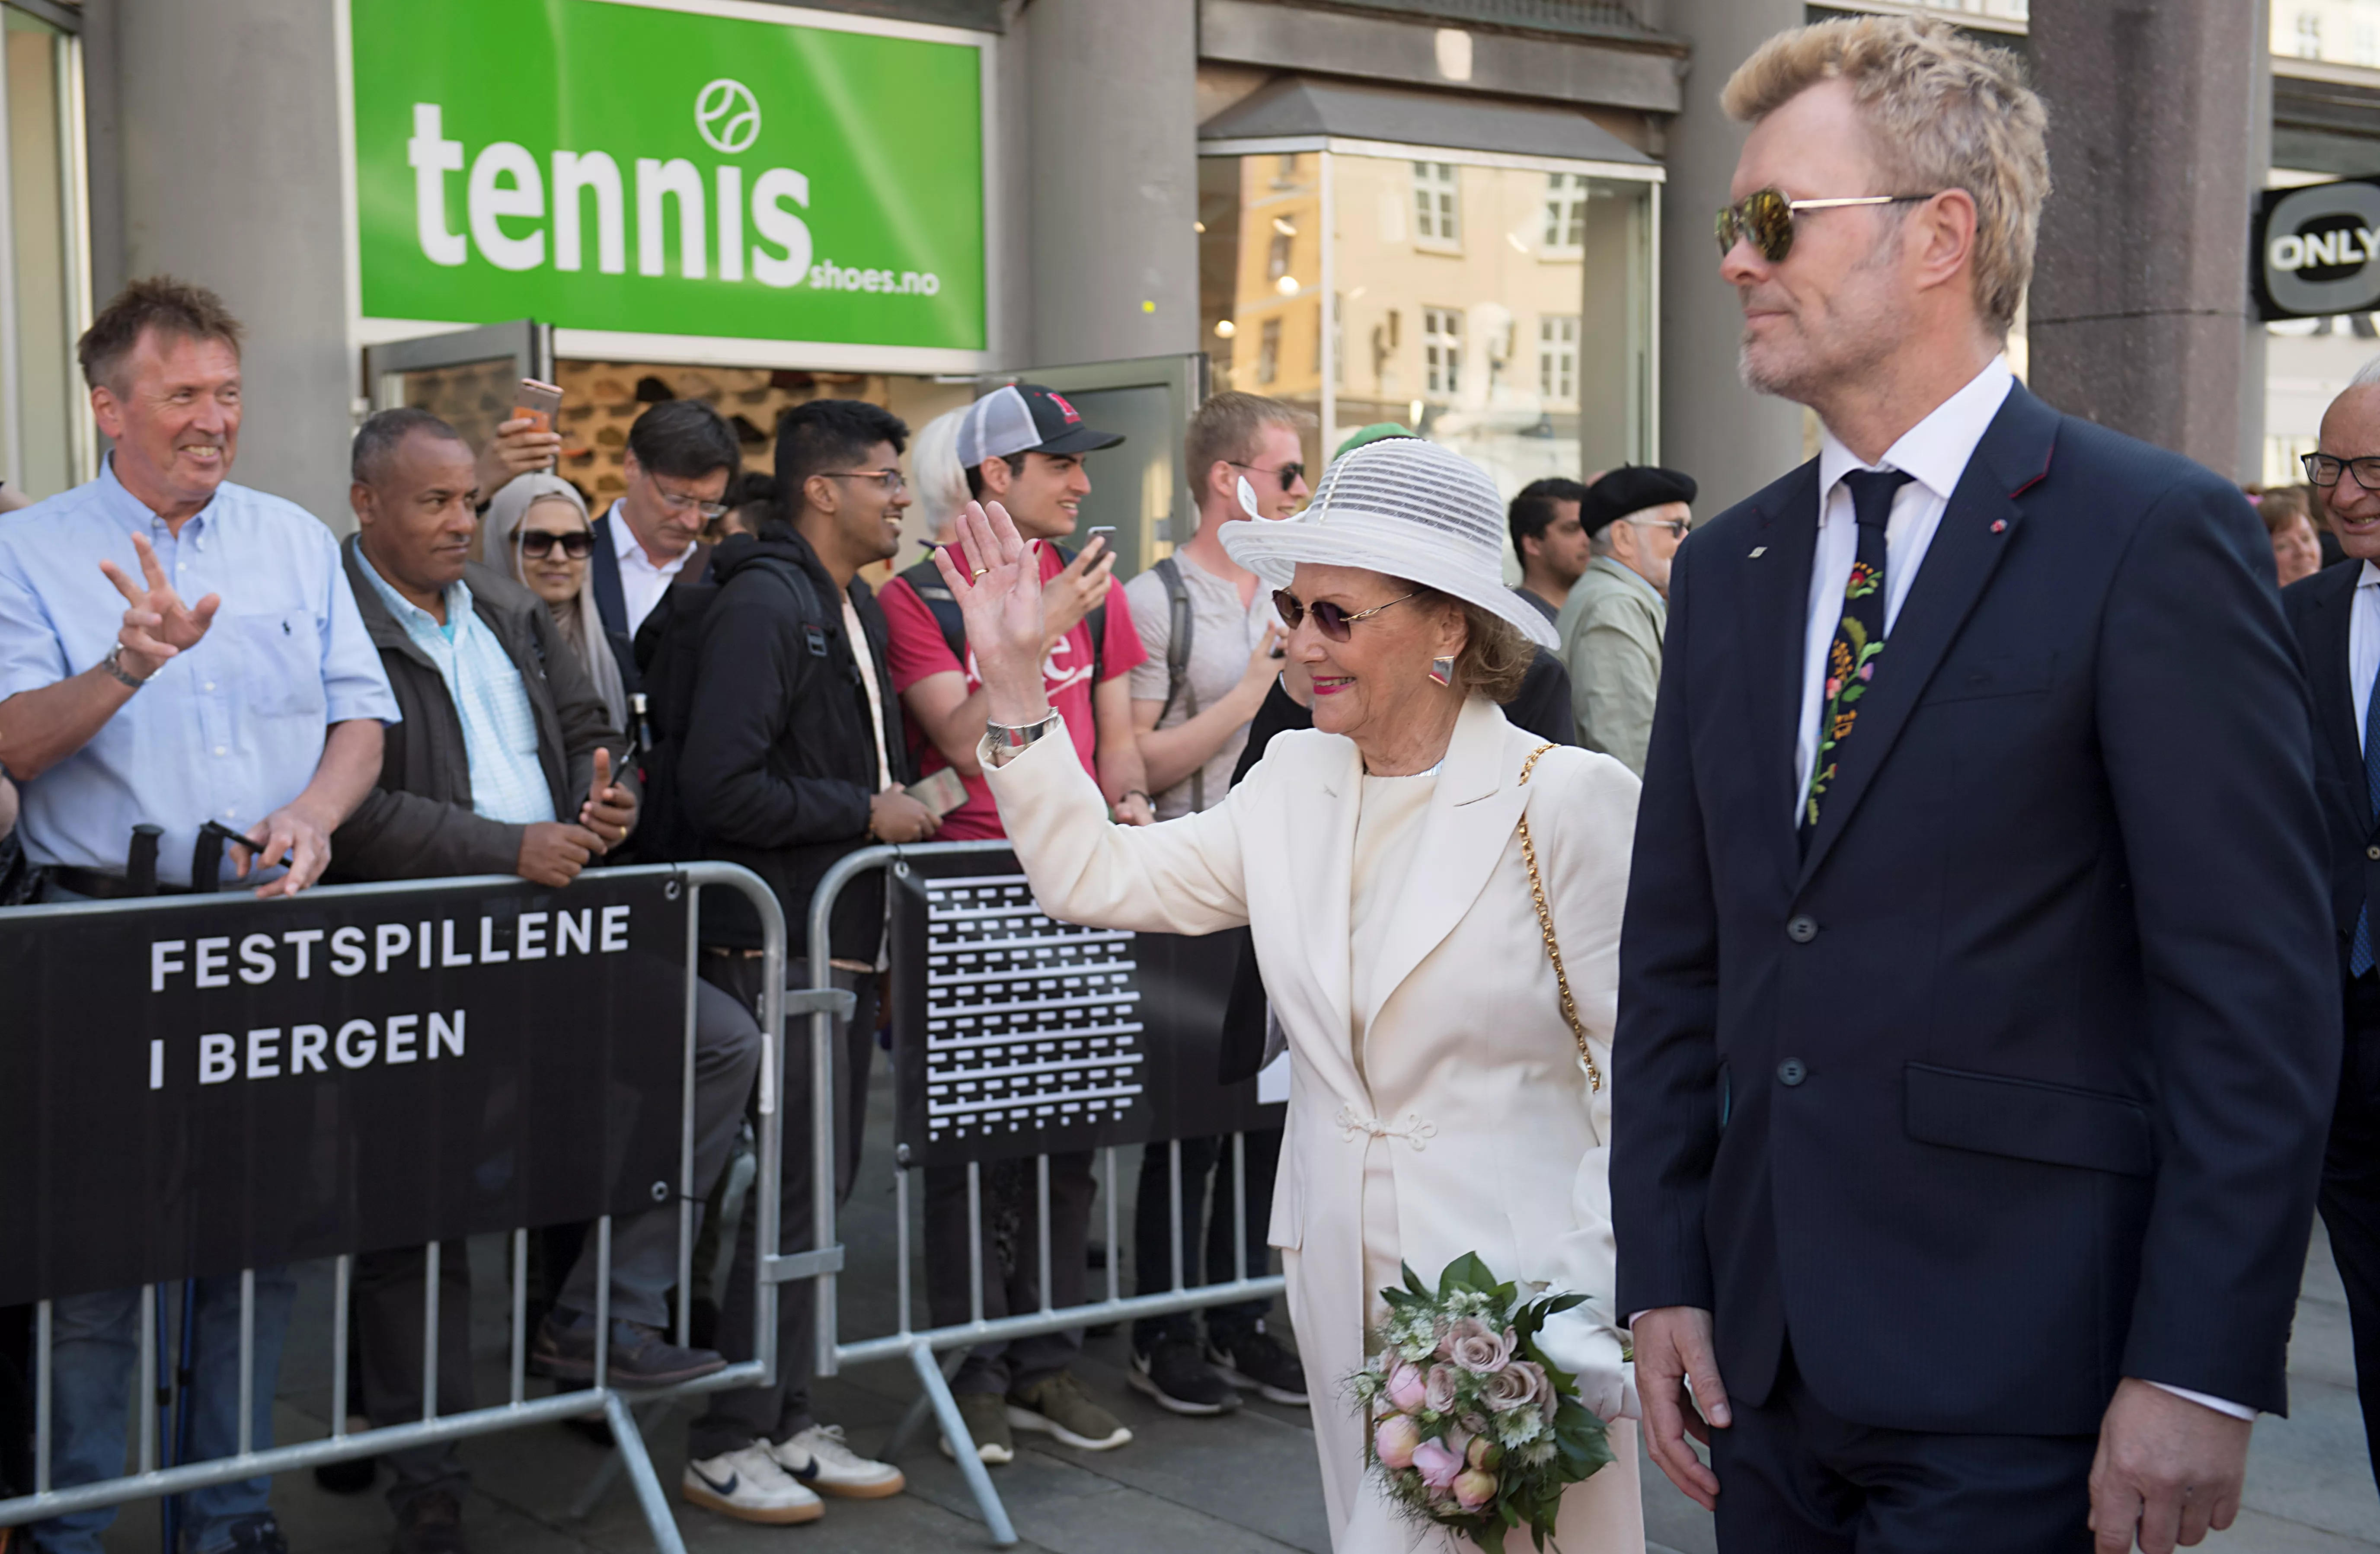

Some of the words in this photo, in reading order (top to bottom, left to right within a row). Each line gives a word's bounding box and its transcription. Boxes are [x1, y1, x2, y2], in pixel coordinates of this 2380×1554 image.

[408, 79, 813, 288] tennis
[810, 258, 940, 296] shoes.no
[2270, 227, 2380, 271] ONLY
[151, 905, 630, 992] FESTSPILLENE
[149, 1039, 164, 1090] I
[198, 1010, 466, 1084] BERGEN
